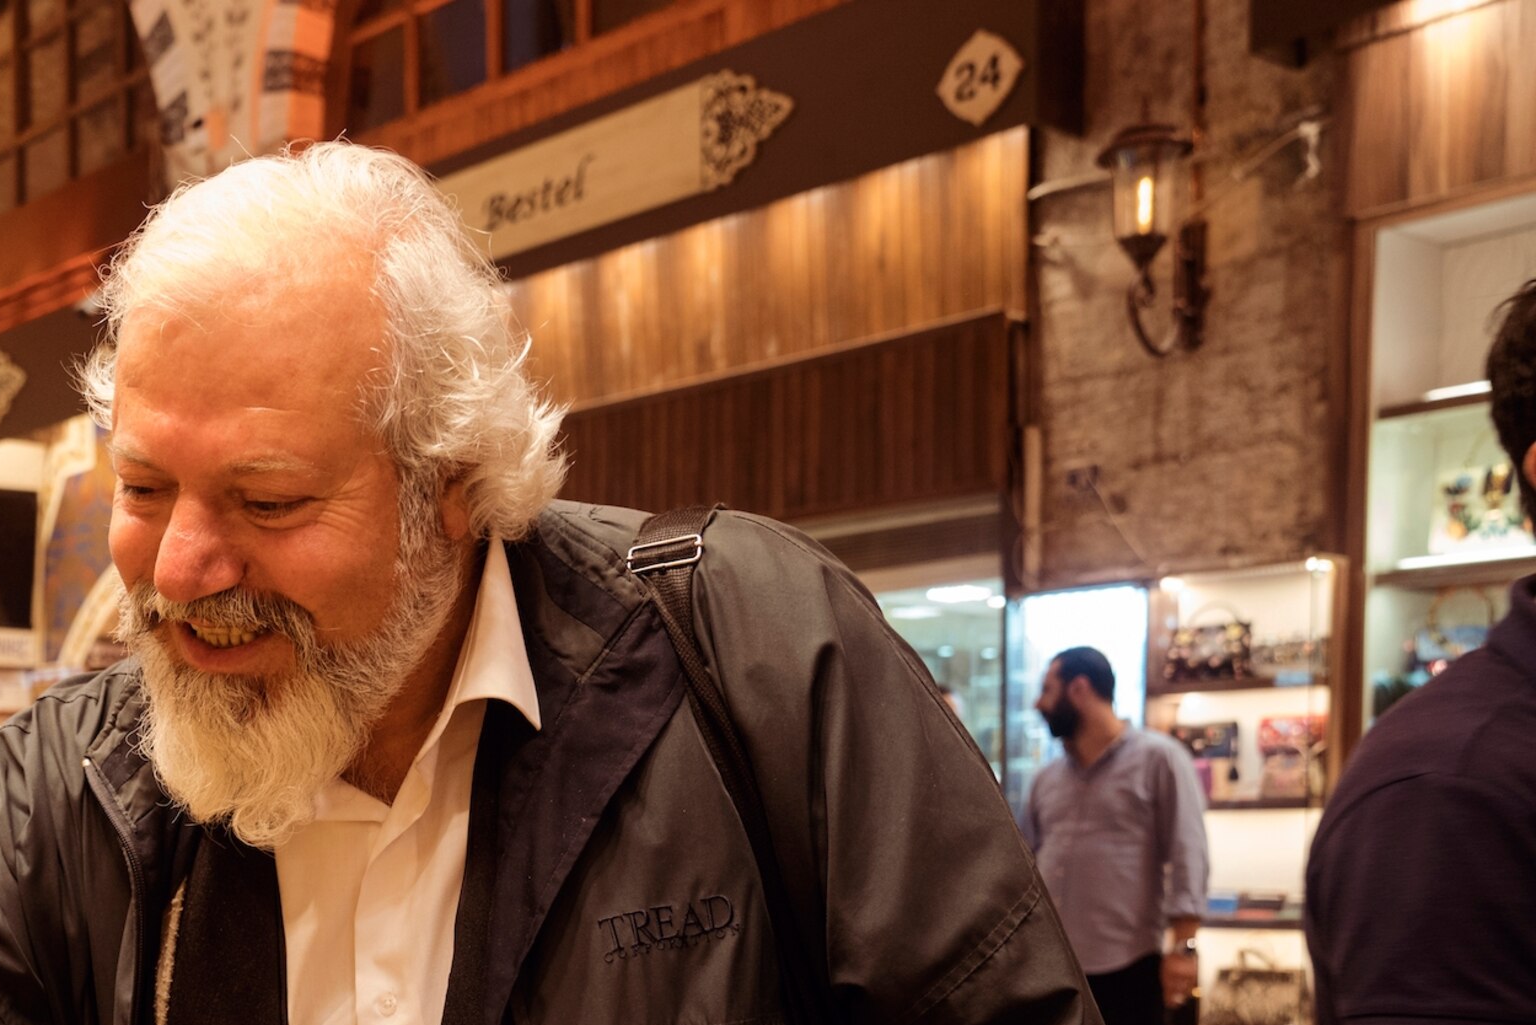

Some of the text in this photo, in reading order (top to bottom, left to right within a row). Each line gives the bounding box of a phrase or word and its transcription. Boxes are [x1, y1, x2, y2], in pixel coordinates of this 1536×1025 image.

[955, 53, 1000, 102] 24
[482, 153, 595, 231] Bestel
[598, 895, 735, 954] TREAD
